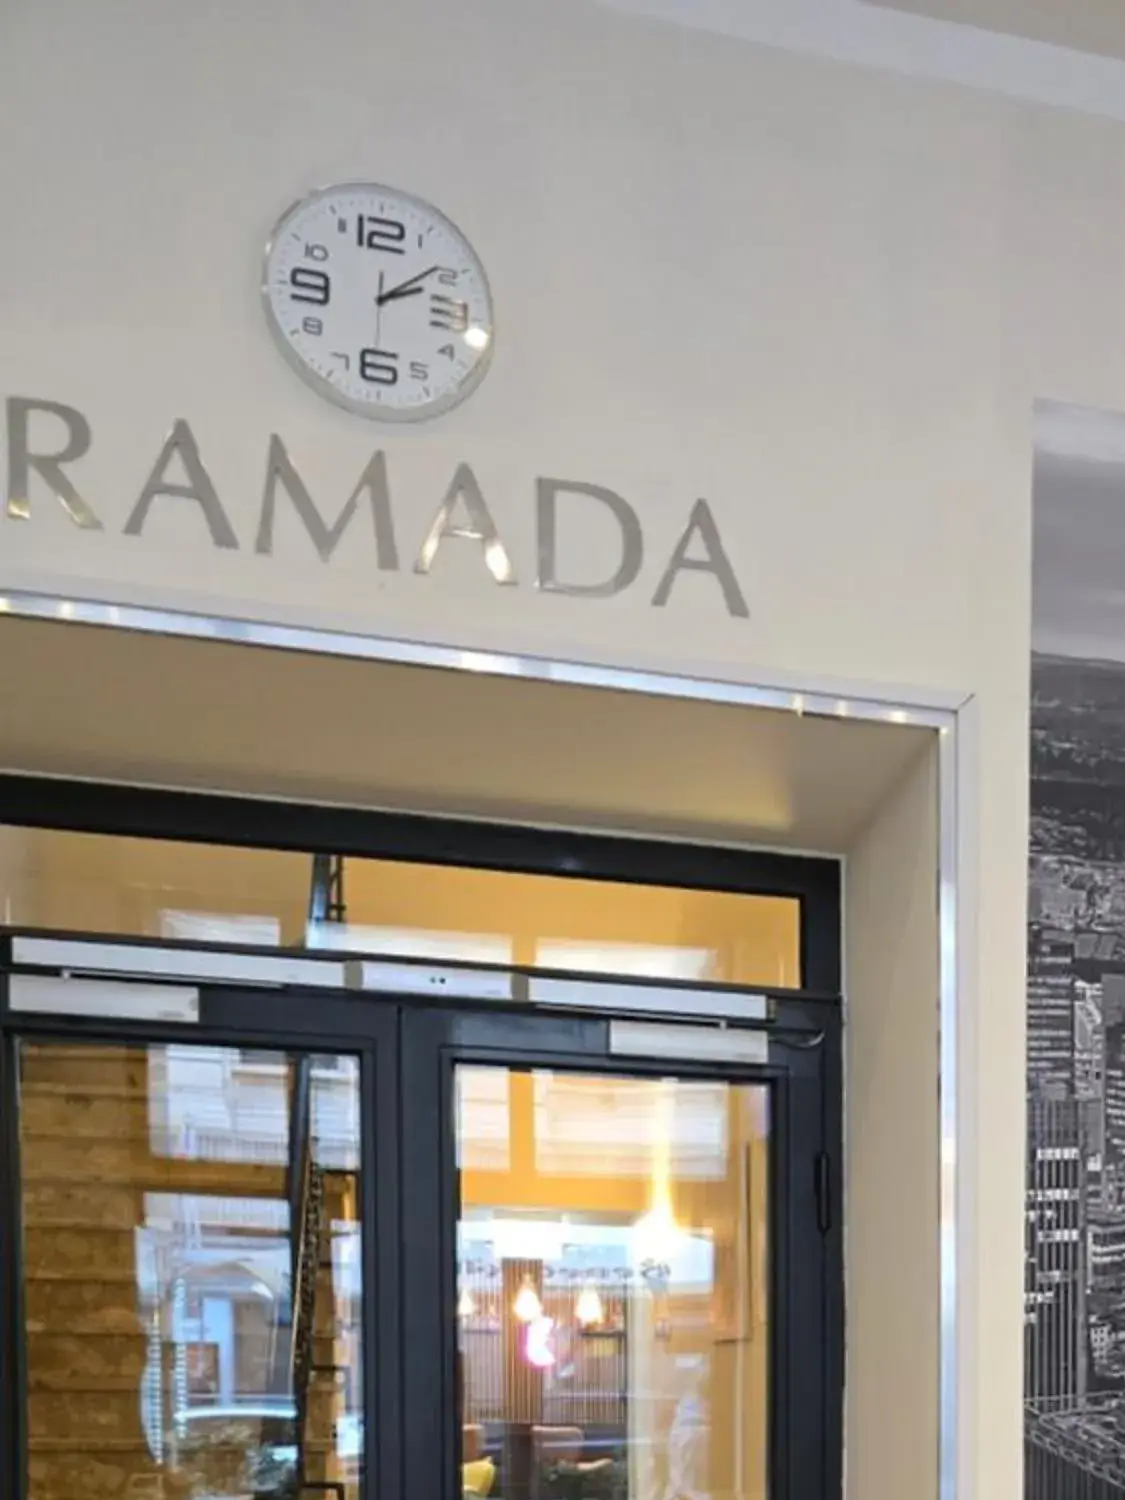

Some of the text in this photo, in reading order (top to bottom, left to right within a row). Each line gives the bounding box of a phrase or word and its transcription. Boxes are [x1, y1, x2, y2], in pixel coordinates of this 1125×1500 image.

[357, 213, 406, 255] 12
[304, 243, 330, 262] 10
[290, 267, 330, 306] 9
[437, 267, 459, 288] 2
[429, 294, 469, 333] 3
[302, 316, 323, 337] 8
[331, 351, 350, 372] 7
[437, 343, 456, 362] 4
[359, 347, 398, 386] 6
[409, 361, 430, 382] 5
[5, 395, 751, 619] RAMADA
